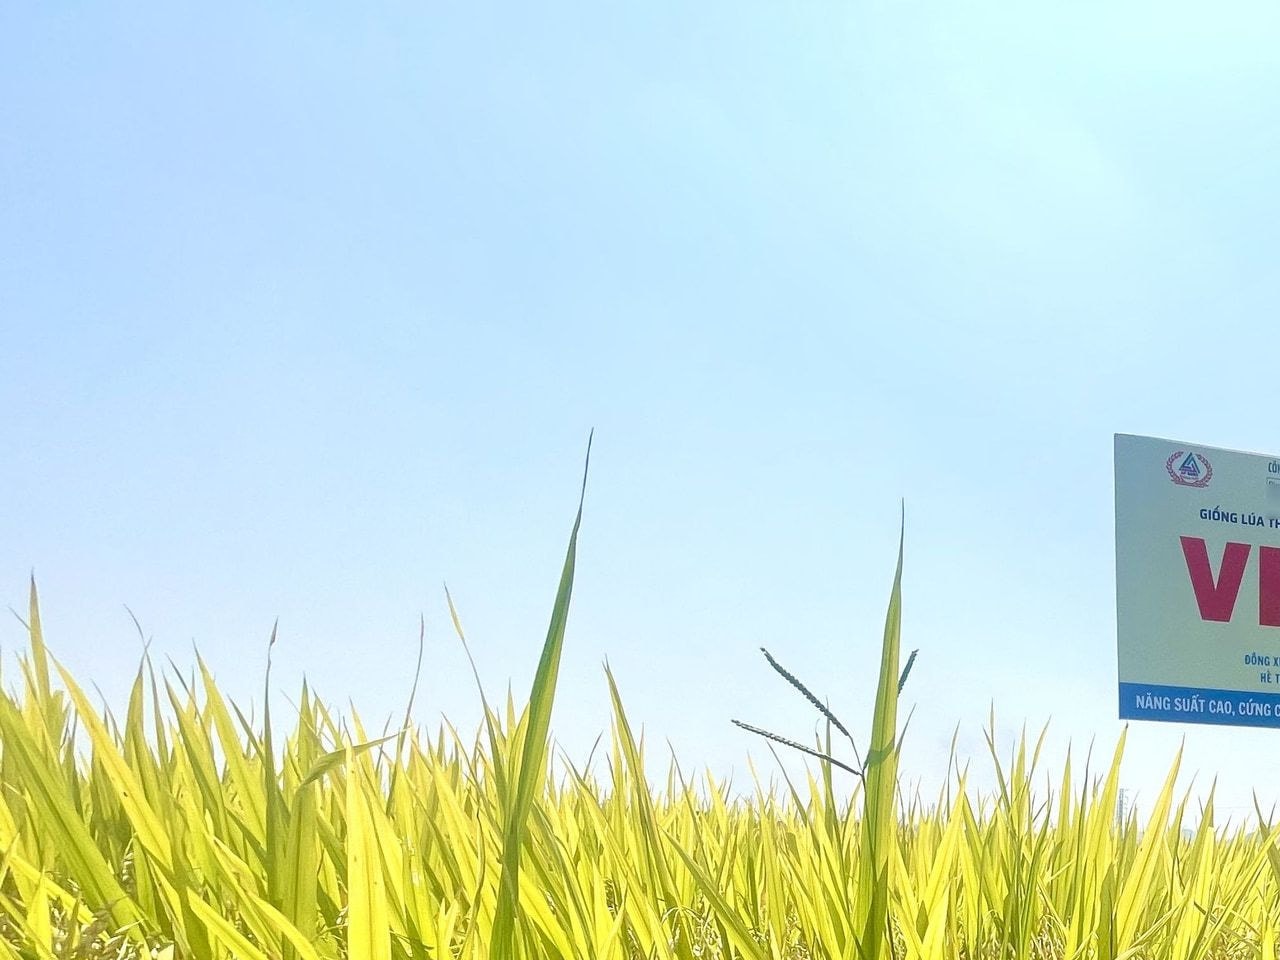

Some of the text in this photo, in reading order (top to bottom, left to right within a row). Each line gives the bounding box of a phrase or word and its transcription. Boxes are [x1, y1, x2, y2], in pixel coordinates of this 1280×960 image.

[1200, 506, 1238, 524] GIỐNG
[1241, 512, 1265, 527] LÚA
[1136, 693, 1171, 711] NĂNG
[1174, 694, 1206, 713] SUẤT
[1209, 700, 1236, 717] CAO,
[1238, 698, 1272, 717] CỨNG
